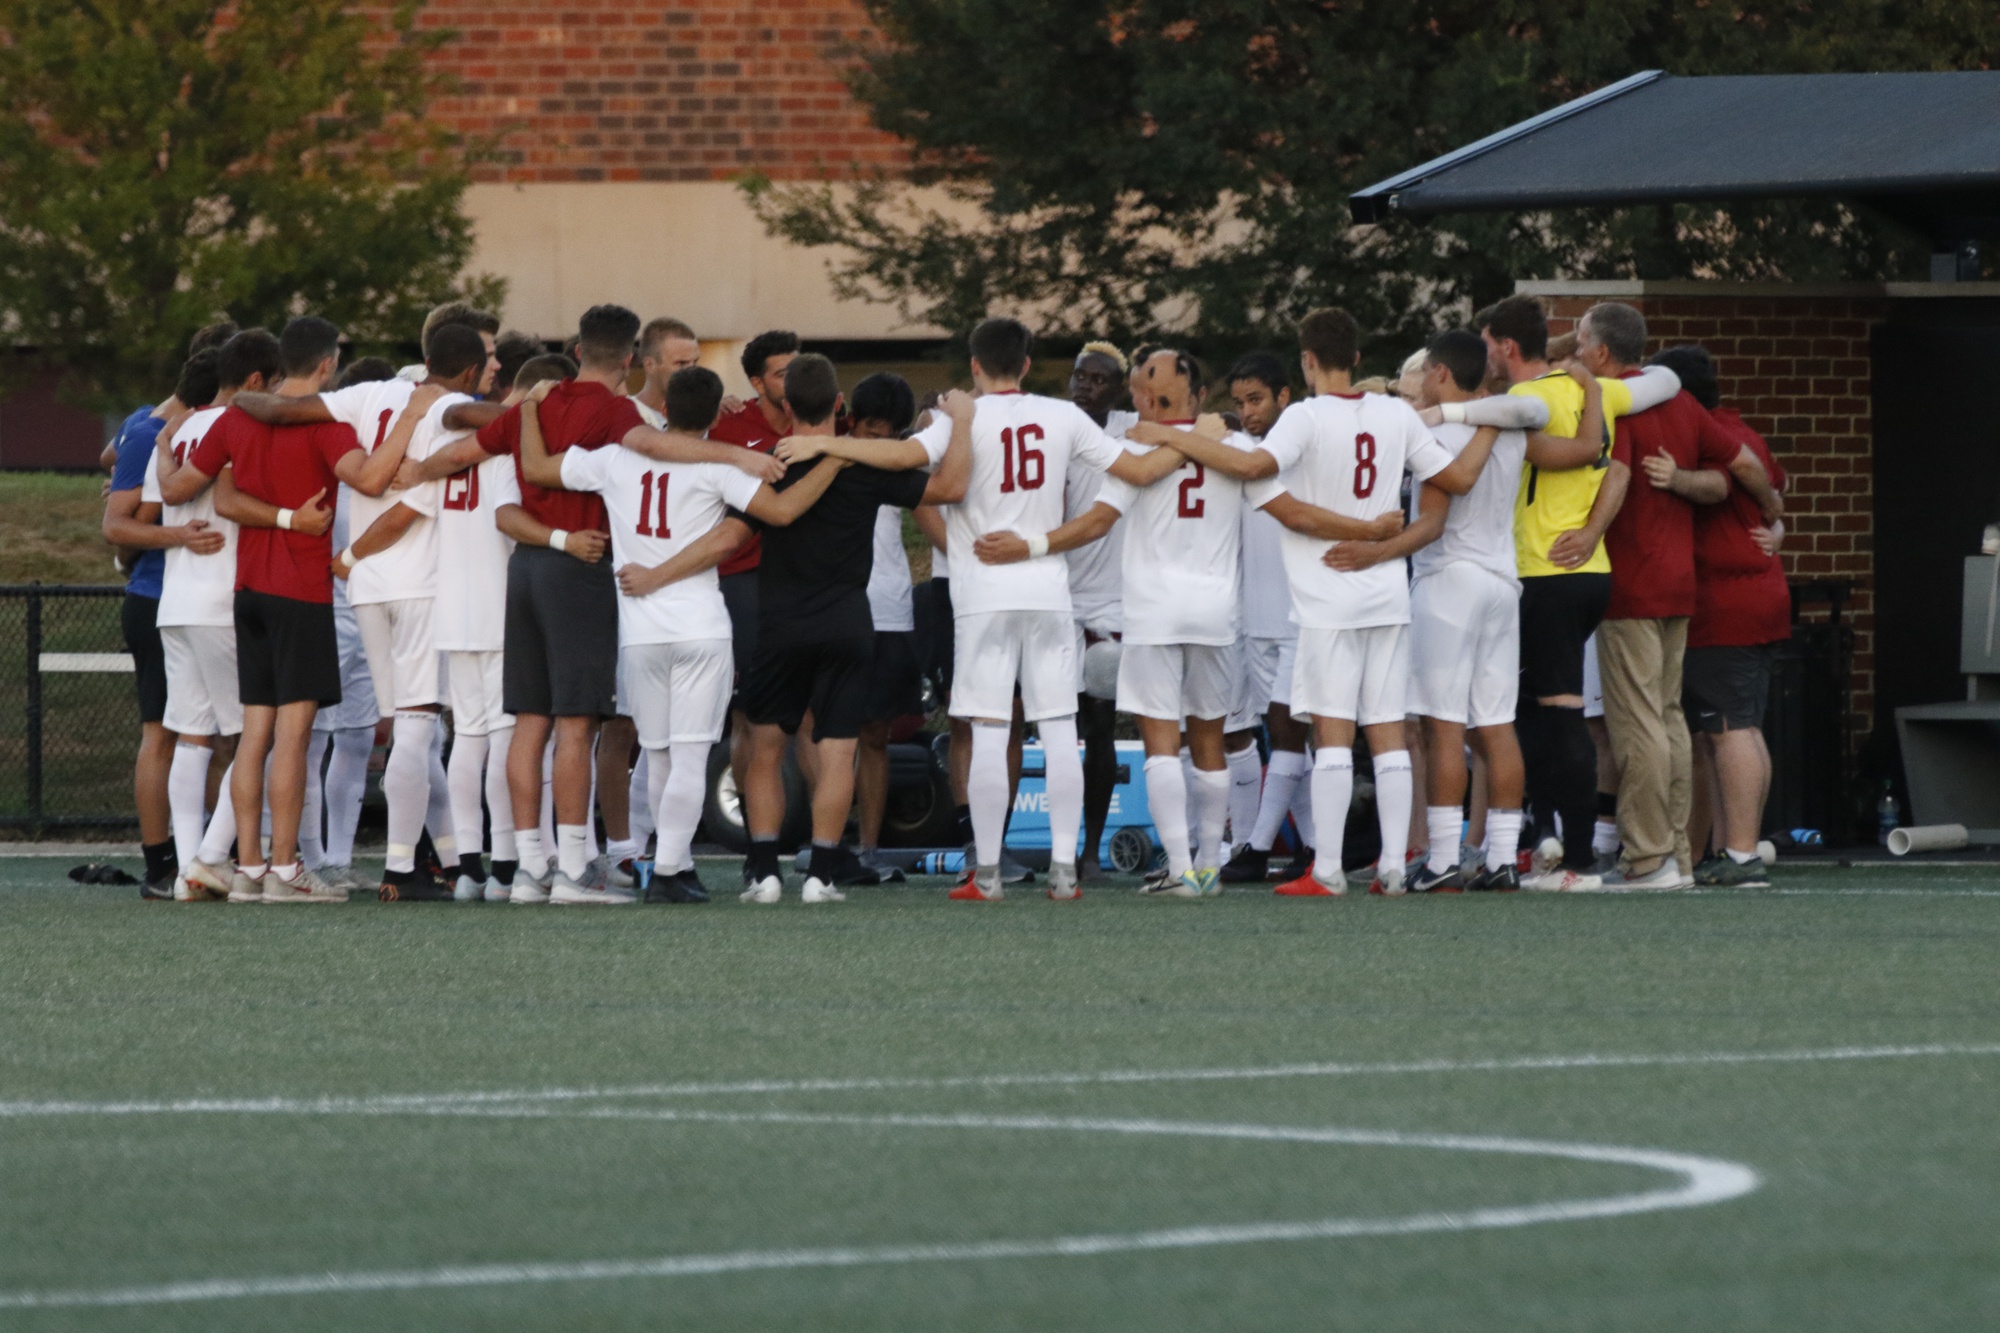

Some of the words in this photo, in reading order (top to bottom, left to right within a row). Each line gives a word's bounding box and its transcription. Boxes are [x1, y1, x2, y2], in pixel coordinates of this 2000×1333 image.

[1000, 423, 1045, 493] 16
[1178, 459, 1204, 518] 2
[1353, 432, 1377, 500] 8
[636, 470, 671, 539] 11
